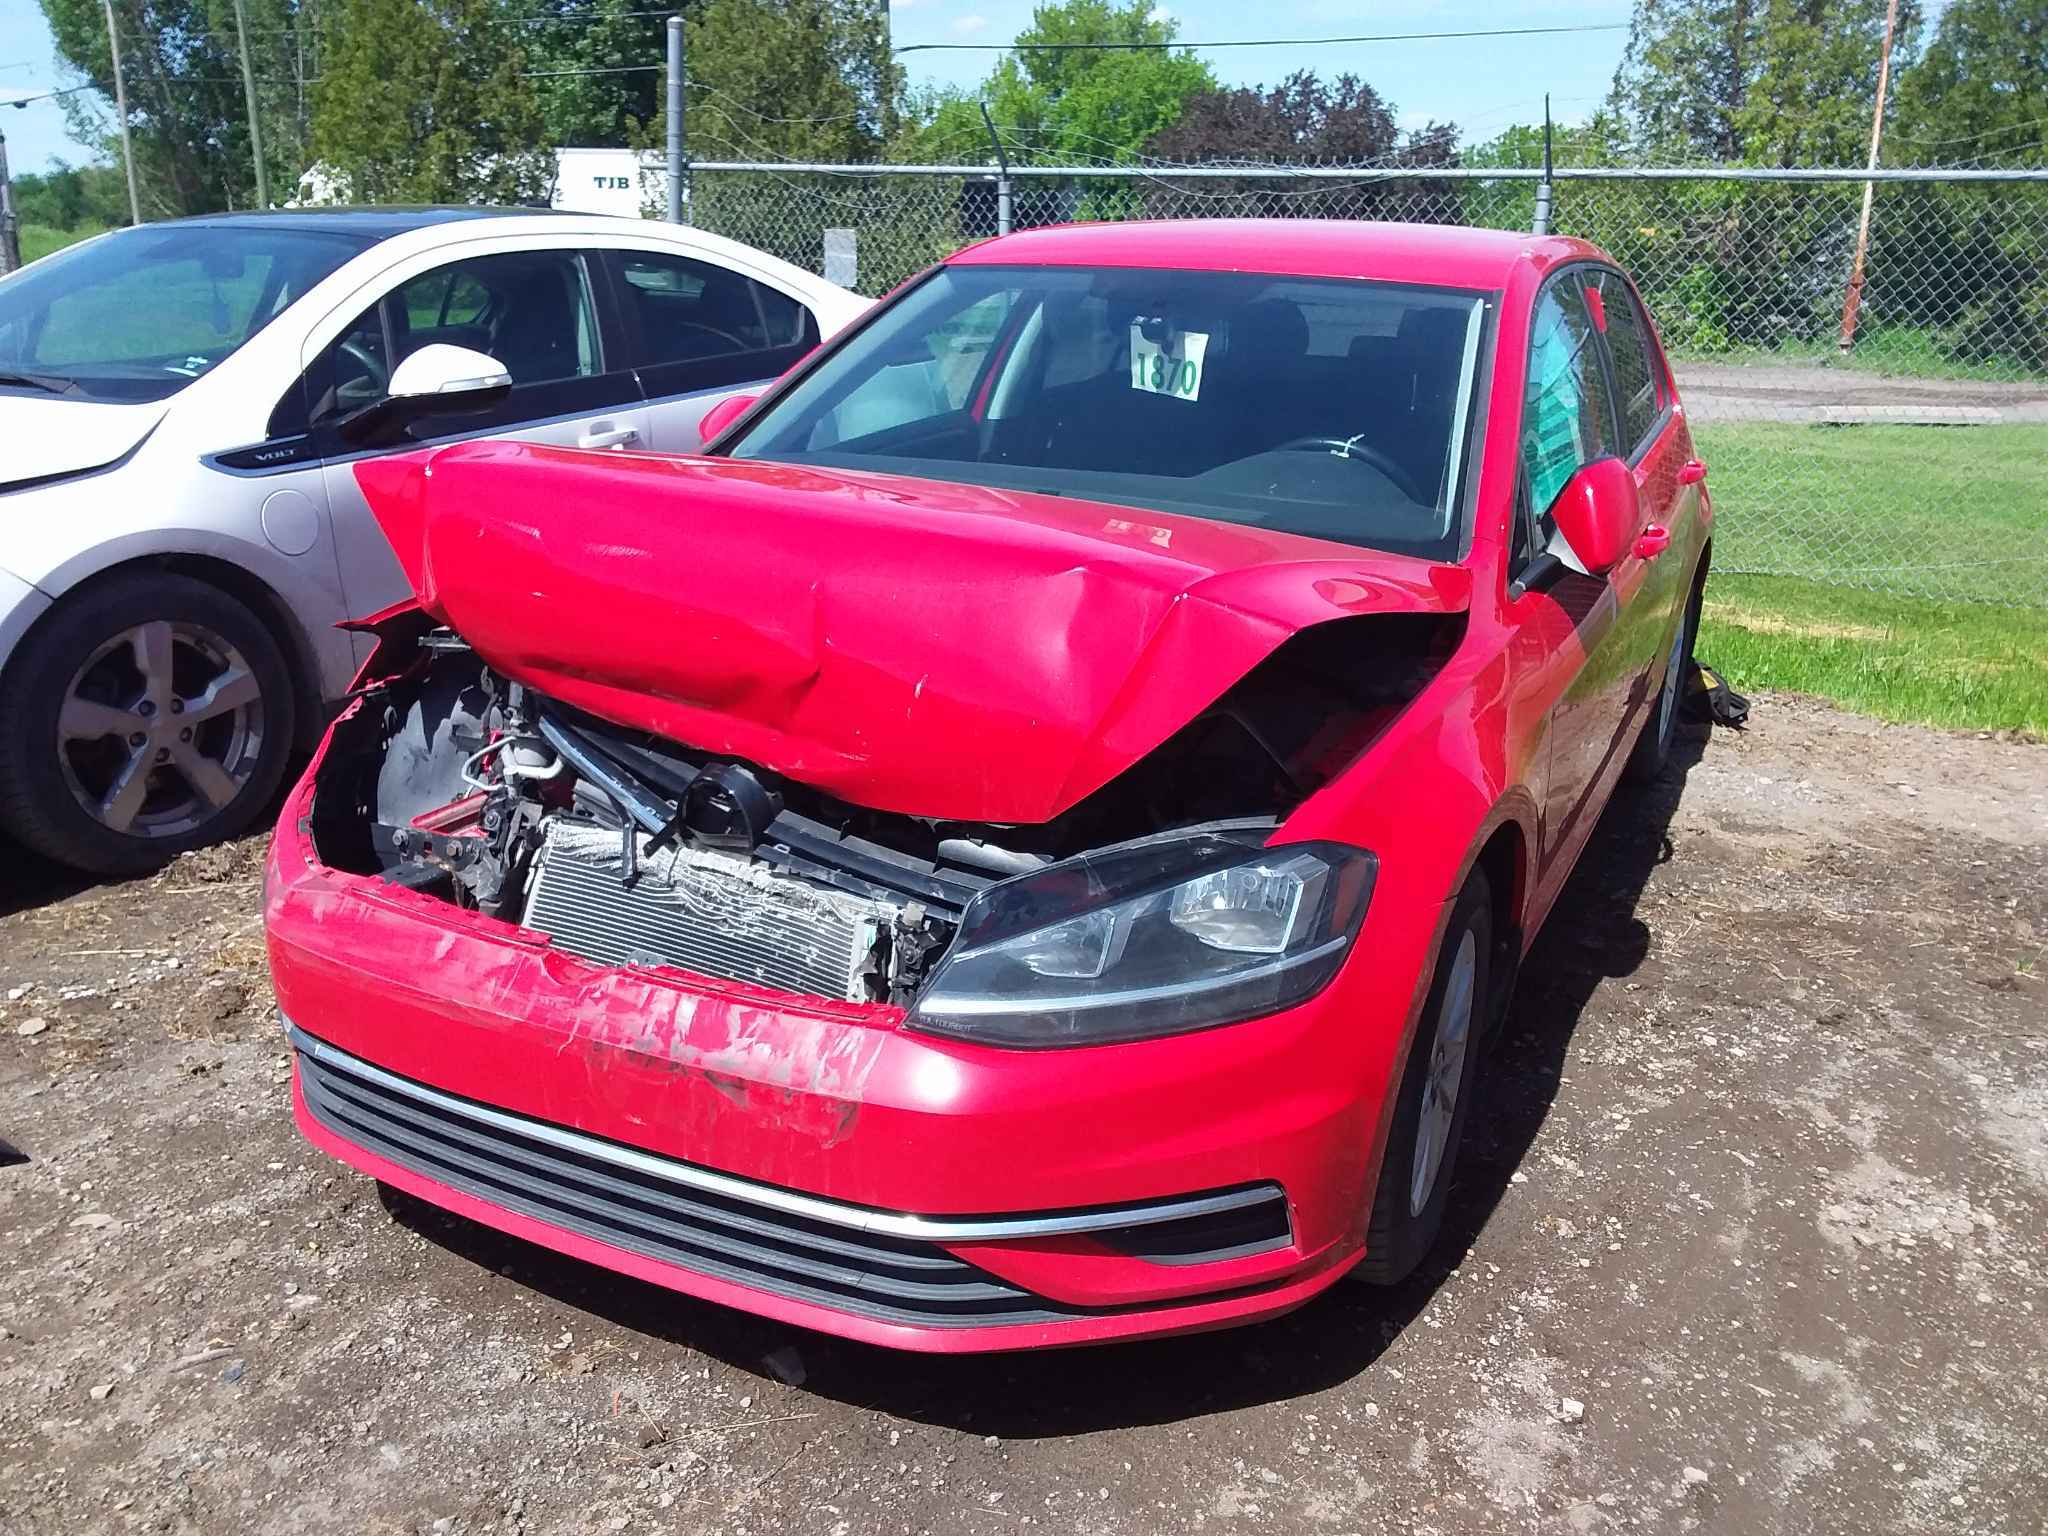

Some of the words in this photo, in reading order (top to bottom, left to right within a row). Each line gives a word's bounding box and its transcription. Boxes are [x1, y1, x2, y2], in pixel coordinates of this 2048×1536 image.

[593, 176, 630, 189] TJB
[1137, 353, 1197, 395] 1870
[255, 449, 296, 460] VOLT
